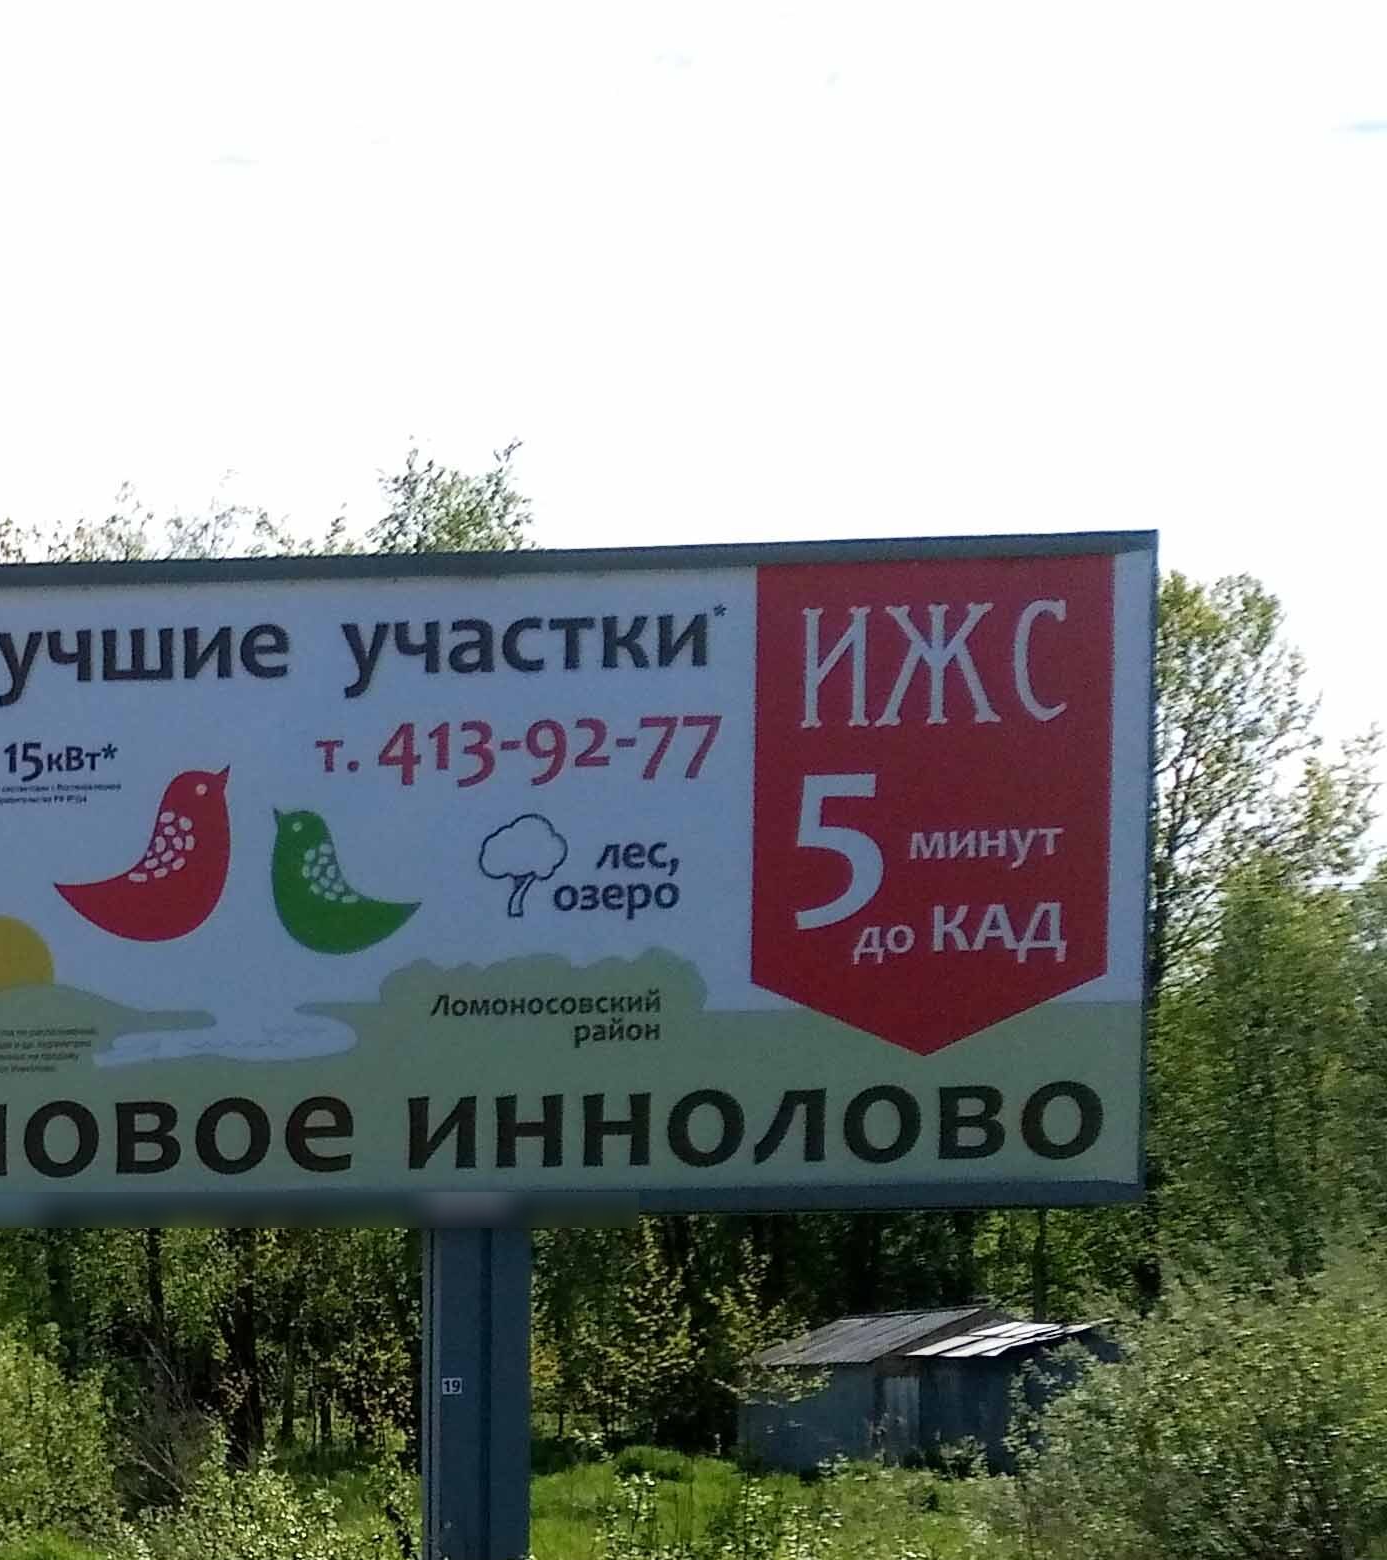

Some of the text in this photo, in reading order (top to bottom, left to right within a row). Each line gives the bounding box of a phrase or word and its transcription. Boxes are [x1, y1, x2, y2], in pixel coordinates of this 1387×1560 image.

[800, 598, 1068, 729] ИЖС
[376, 714, 723, 789] 413-92-77
[595, 840, 680, 877] лес,
[794, 772, 1064, 931] 5 минут
[552, 881, 681, 921] озеро
[850, 900, 1068, 966] до КАД
[429, 988, 662, 1017] Ломоносовский
[573, 1018, 662, 1049] район
[443, 1380, 460, 1393] 19
